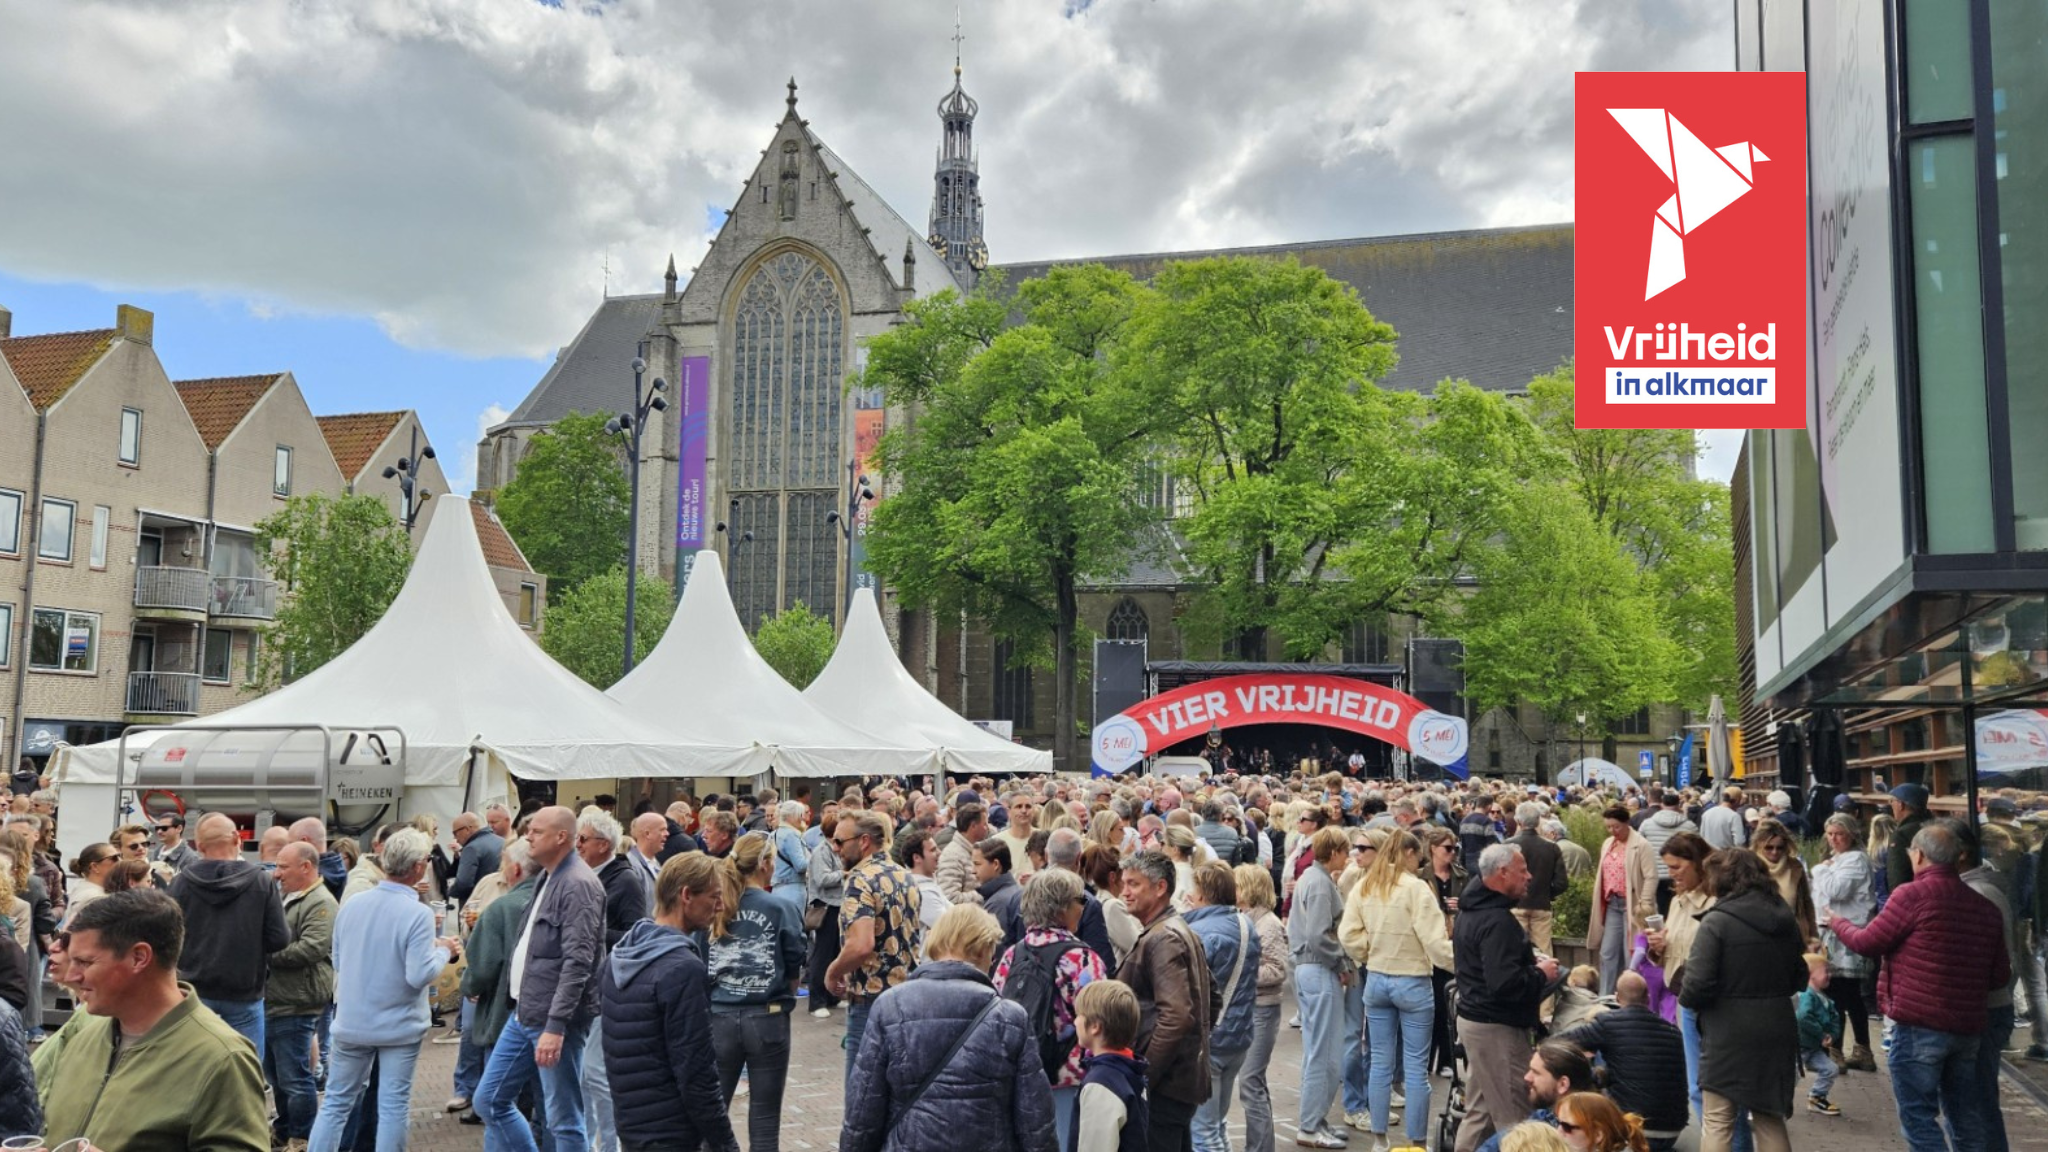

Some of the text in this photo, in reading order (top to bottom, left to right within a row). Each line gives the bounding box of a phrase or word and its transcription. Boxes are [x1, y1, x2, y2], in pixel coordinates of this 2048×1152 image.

[680, 488, 691, 541] Ontdek de
[690, 506, 698, 541] nieuwe
[1147, 685, 1401, 735] VIER VRIJHEID
[1102, 737, 1132, 749] 5 MEI
[1423, 728, 1455, 742] 5 MEI
[341, 787, 393, 799] HEINEKEN
[731, 909, 767, 927] IVER
